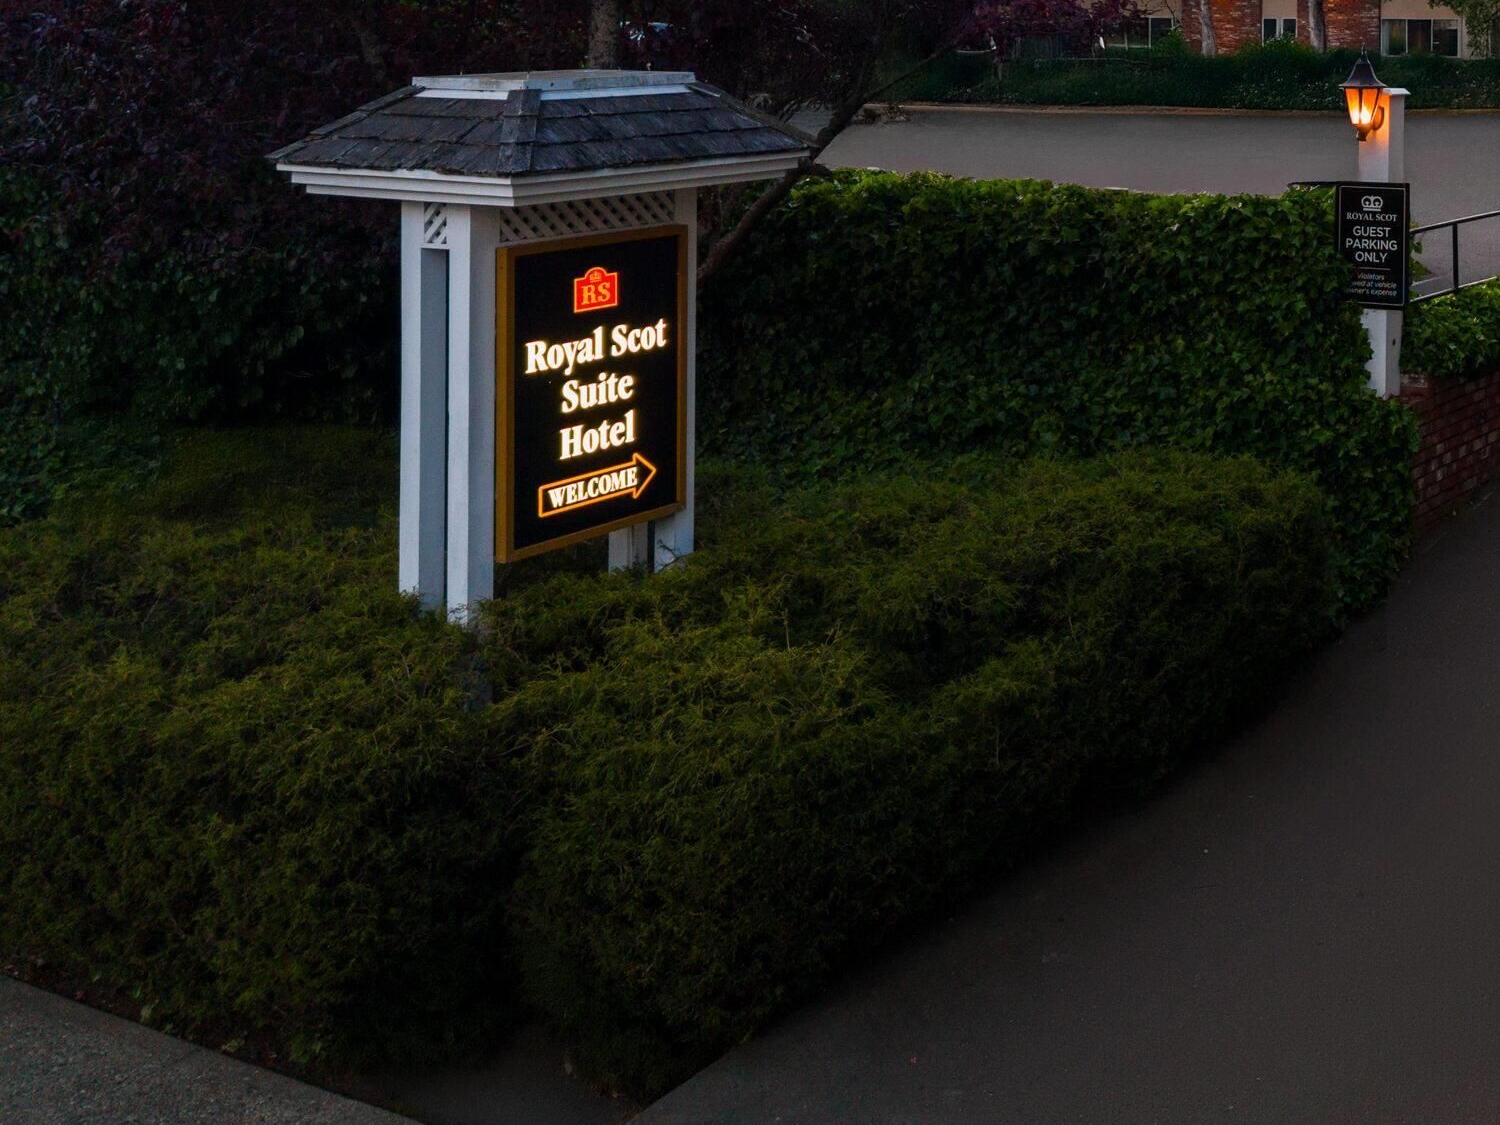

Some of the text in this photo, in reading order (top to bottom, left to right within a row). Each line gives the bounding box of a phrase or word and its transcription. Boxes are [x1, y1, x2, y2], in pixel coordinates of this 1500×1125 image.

[1346, 212, 1397, 222] ROYAL SCOT
[1352, 226, 1391, 237] GUEST
[1345, 238, 1398, 251] PARKING
[1355, 251, 1388, 263] ONLY
[580, 282, 611, 306] RS
[525, 318, 668, 376] Royal Scot
[560, 372, 635, 414] Suite
[558, 409, 636, 461] Hotel
[548, 466, 638, 509] WELCOME
